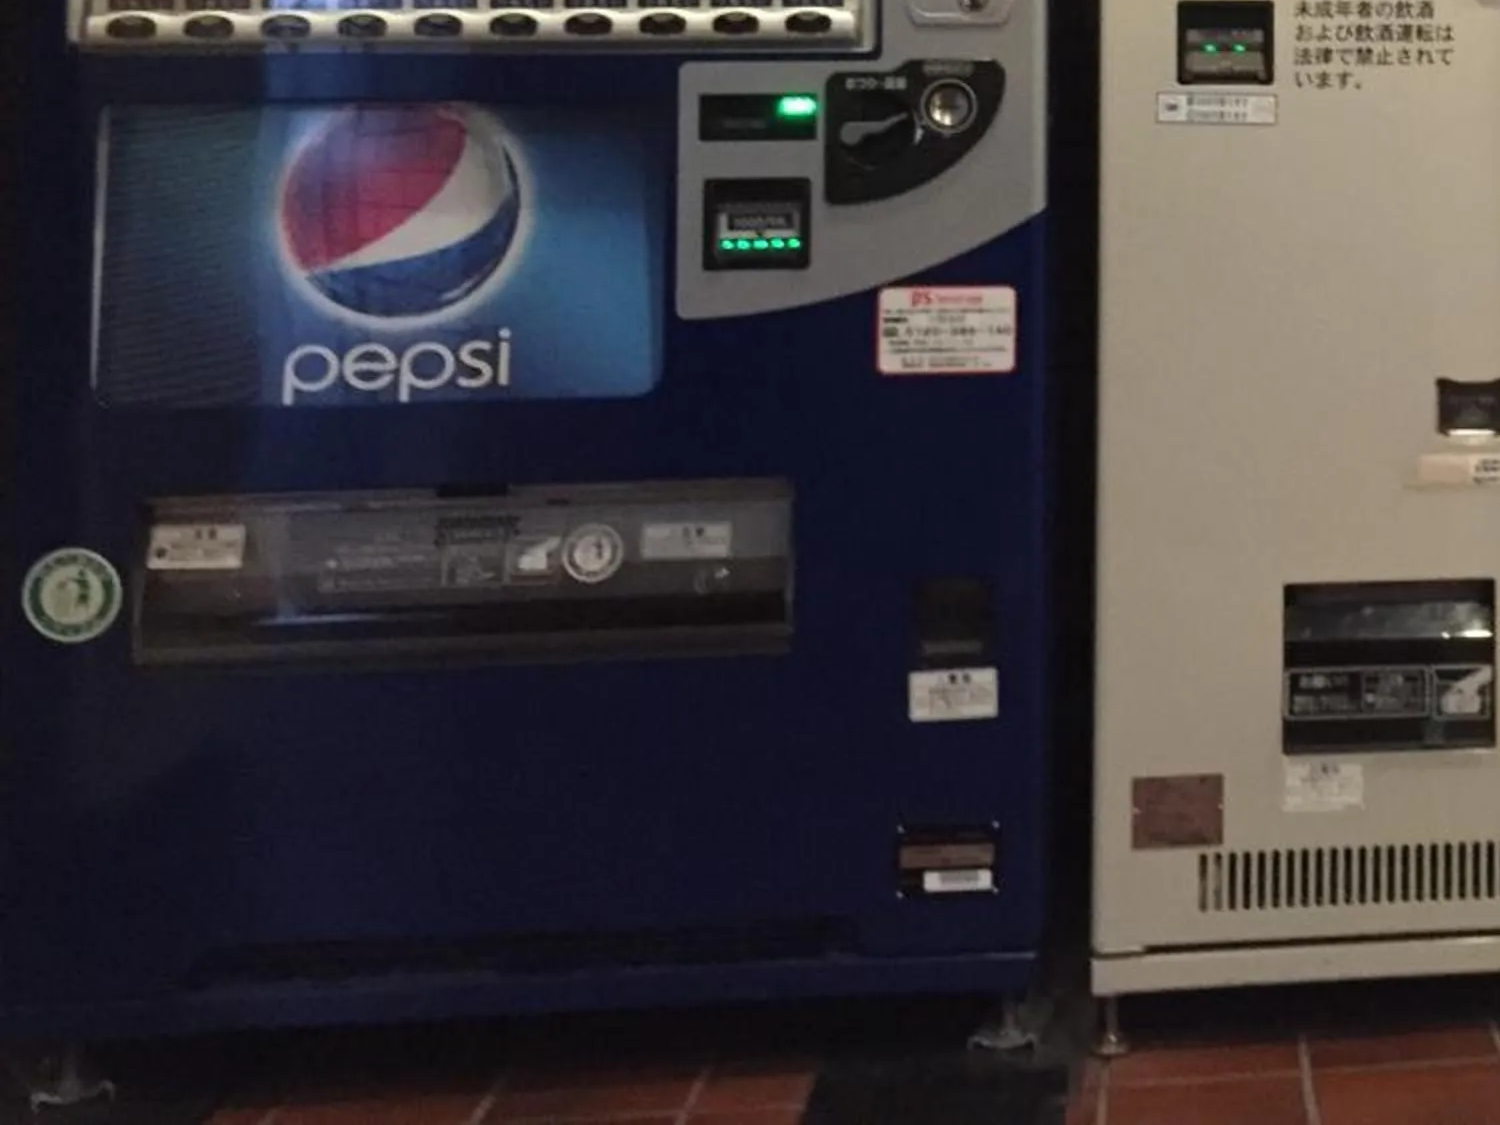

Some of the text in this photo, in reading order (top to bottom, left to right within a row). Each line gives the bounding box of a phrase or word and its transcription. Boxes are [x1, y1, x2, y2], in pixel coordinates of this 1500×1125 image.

[1295, 0, 1435, 19] 未成年者の飲酒
[1295, 24, 1455, 43] および飲酒運転は
[1295, 47, 1454, 66] 法律で禁止されて
[1296, 71, 1363, 90] います。
[282, 326, 512, 406] pepsi
